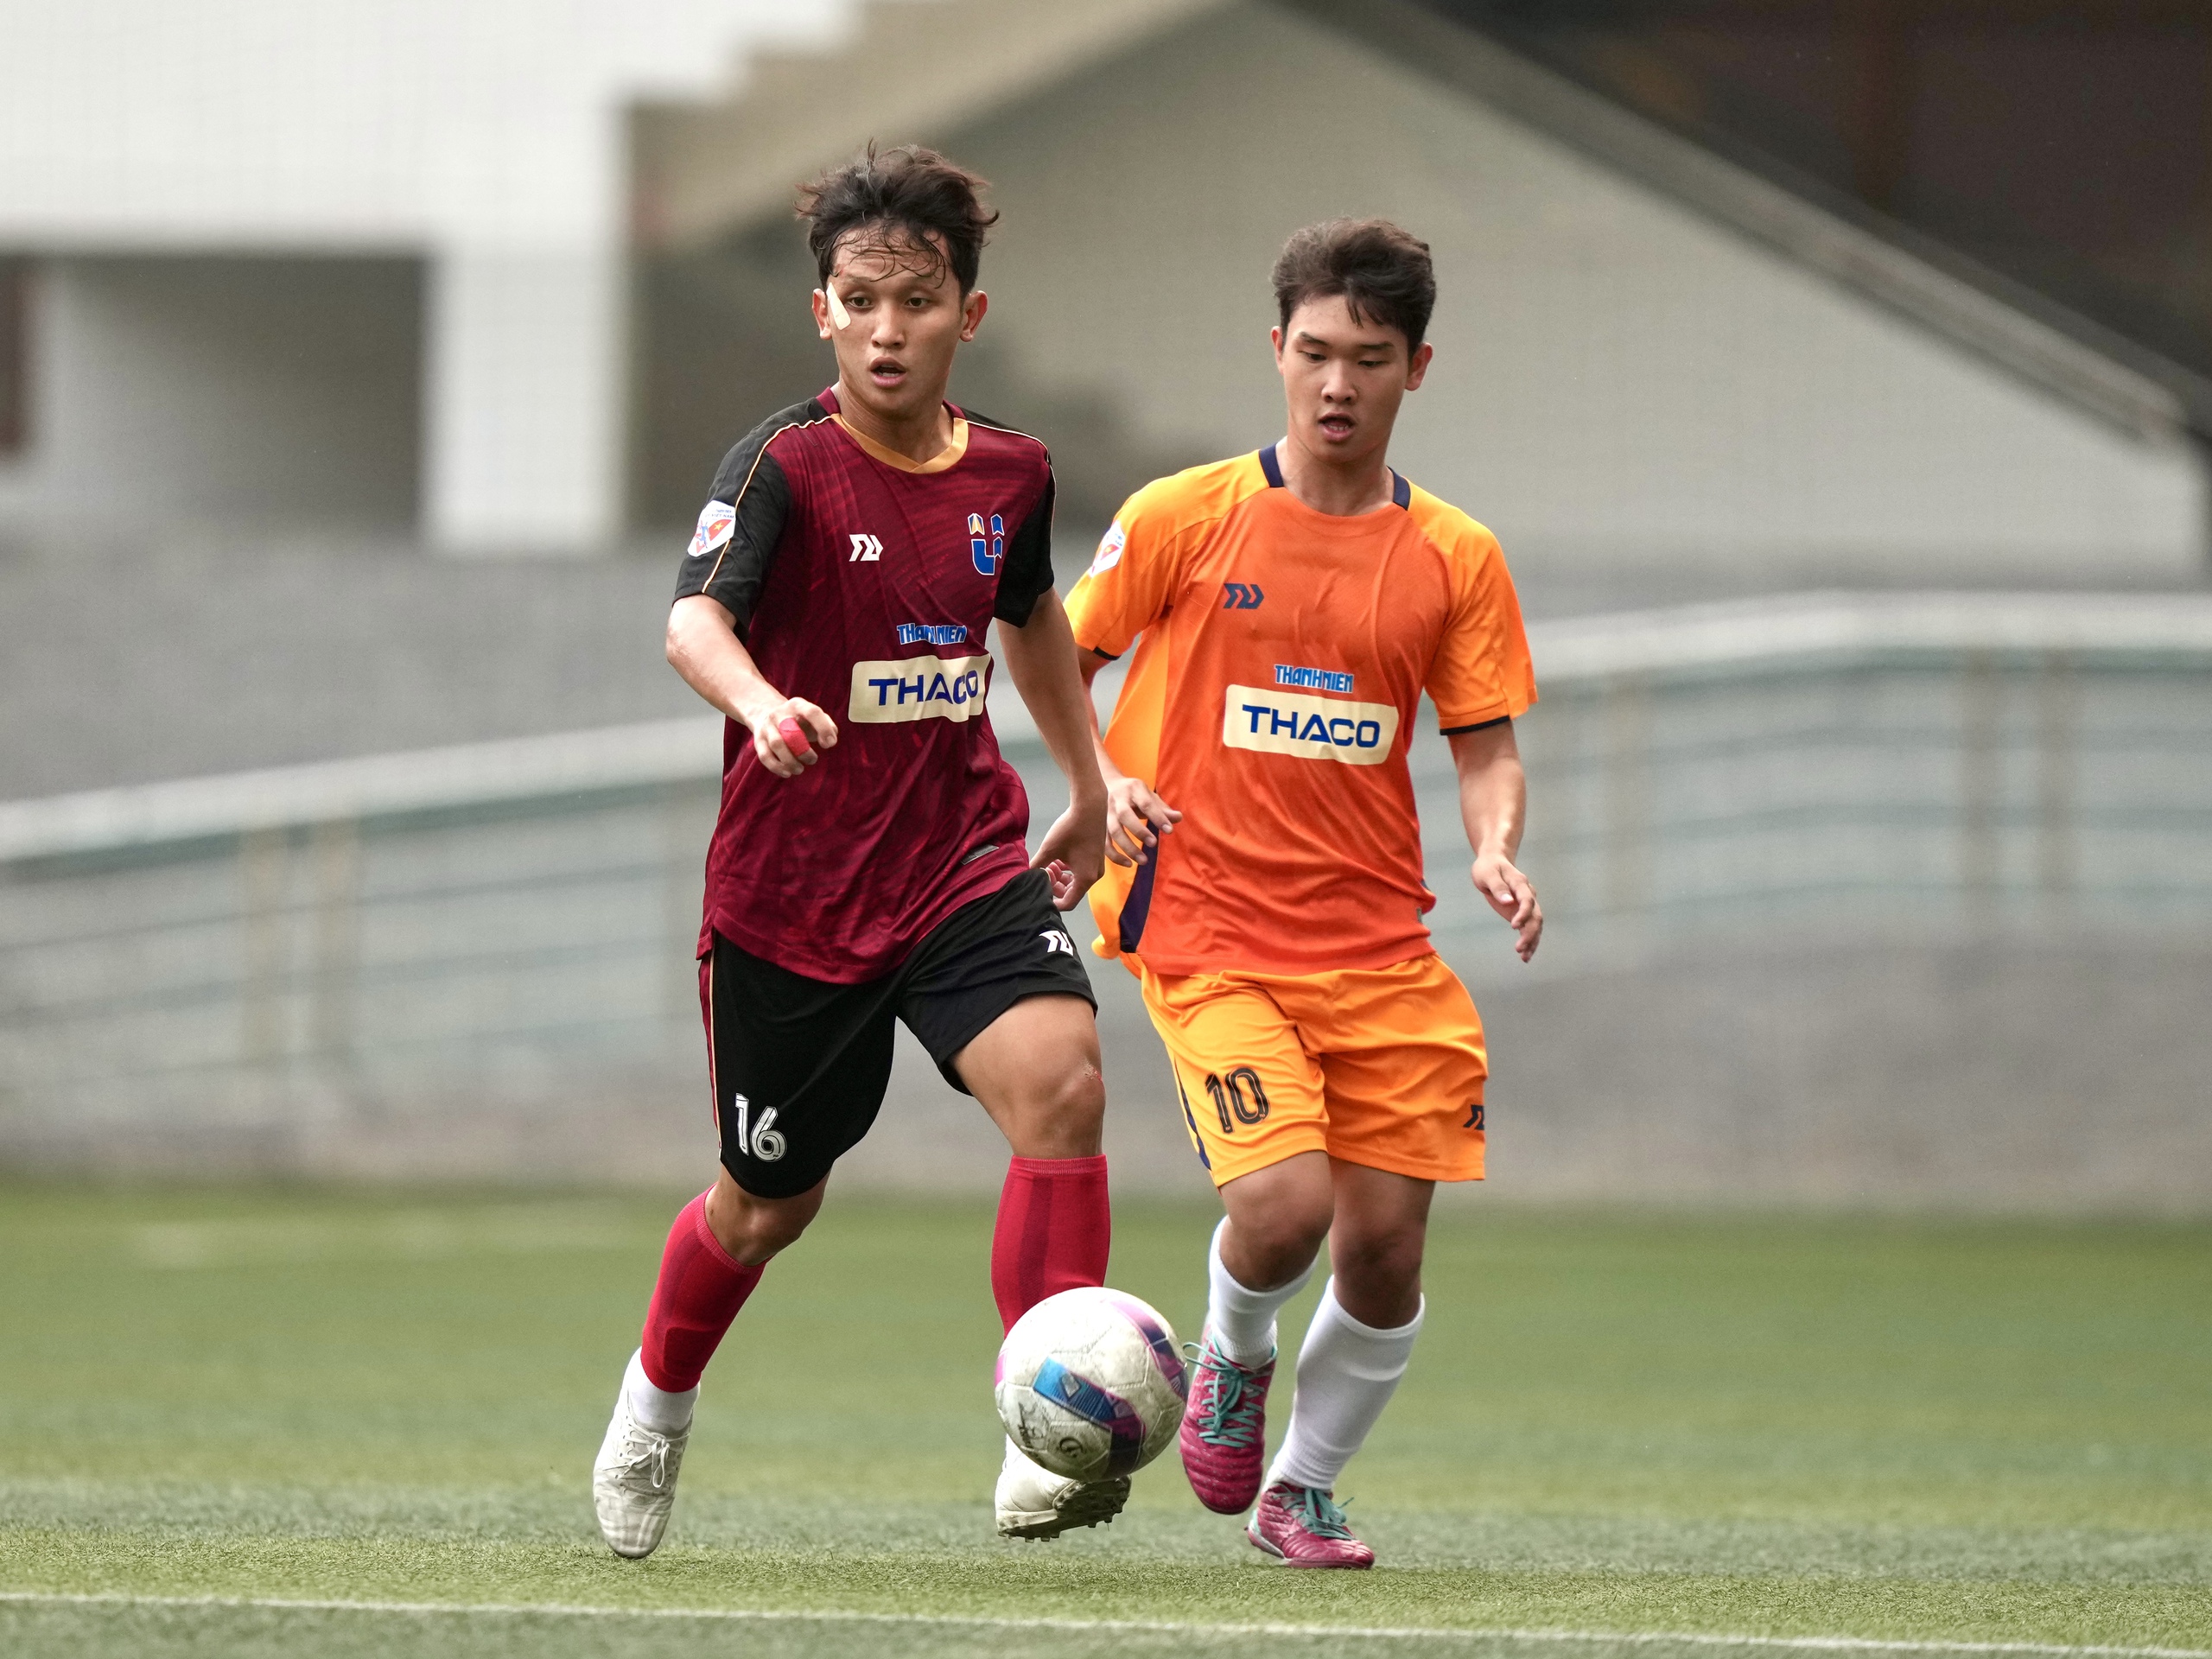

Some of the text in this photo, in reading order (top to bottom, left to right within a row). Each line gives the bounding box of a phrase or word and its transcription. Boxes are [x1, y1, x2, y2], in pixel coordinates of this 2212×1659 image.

[868, 670, 979, 706] THACO
[1242, 703, 1381, 748] THACO
[734, 1092, 788, 1163] 16
[1205, 1065, 1270, 1135] 10
